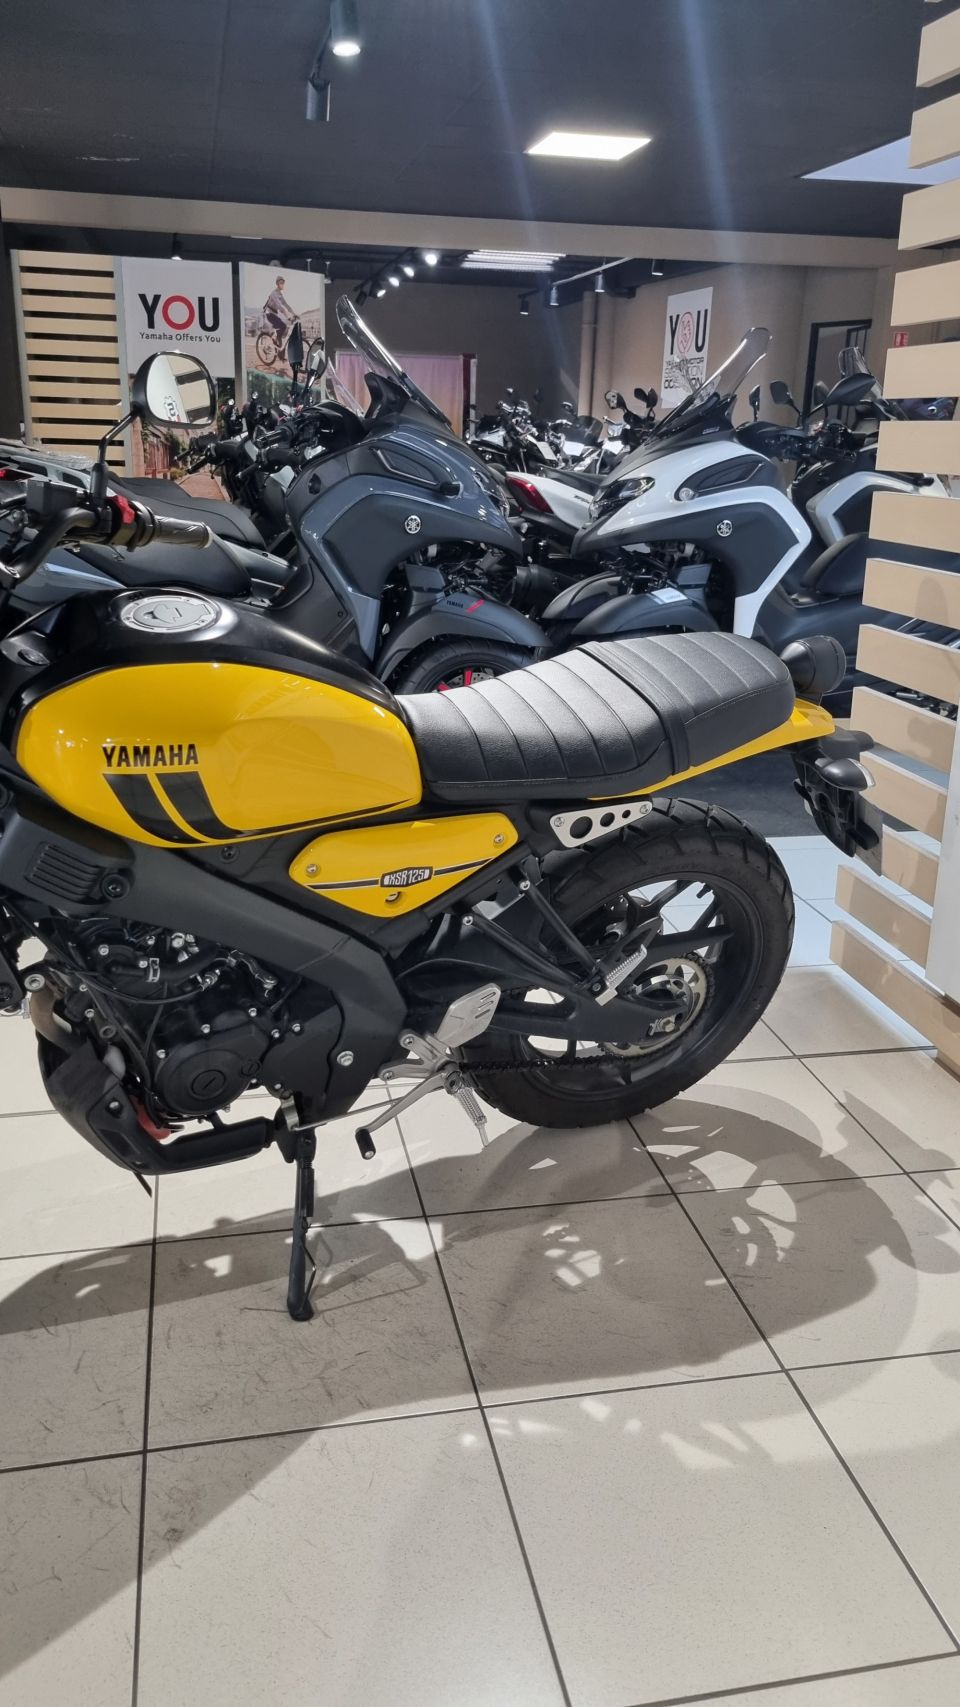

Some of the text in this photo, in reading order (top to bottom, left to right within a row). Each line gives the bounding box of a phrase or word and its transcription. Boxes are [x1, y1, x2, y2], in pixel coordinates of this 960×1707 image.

[138, 293, 220, 332] YOU
[140, 332, 221, 343] Yamaha Offers You
[669, 308, 708, 355] YOU
[102, 744, 199, 768] YAMAHA
